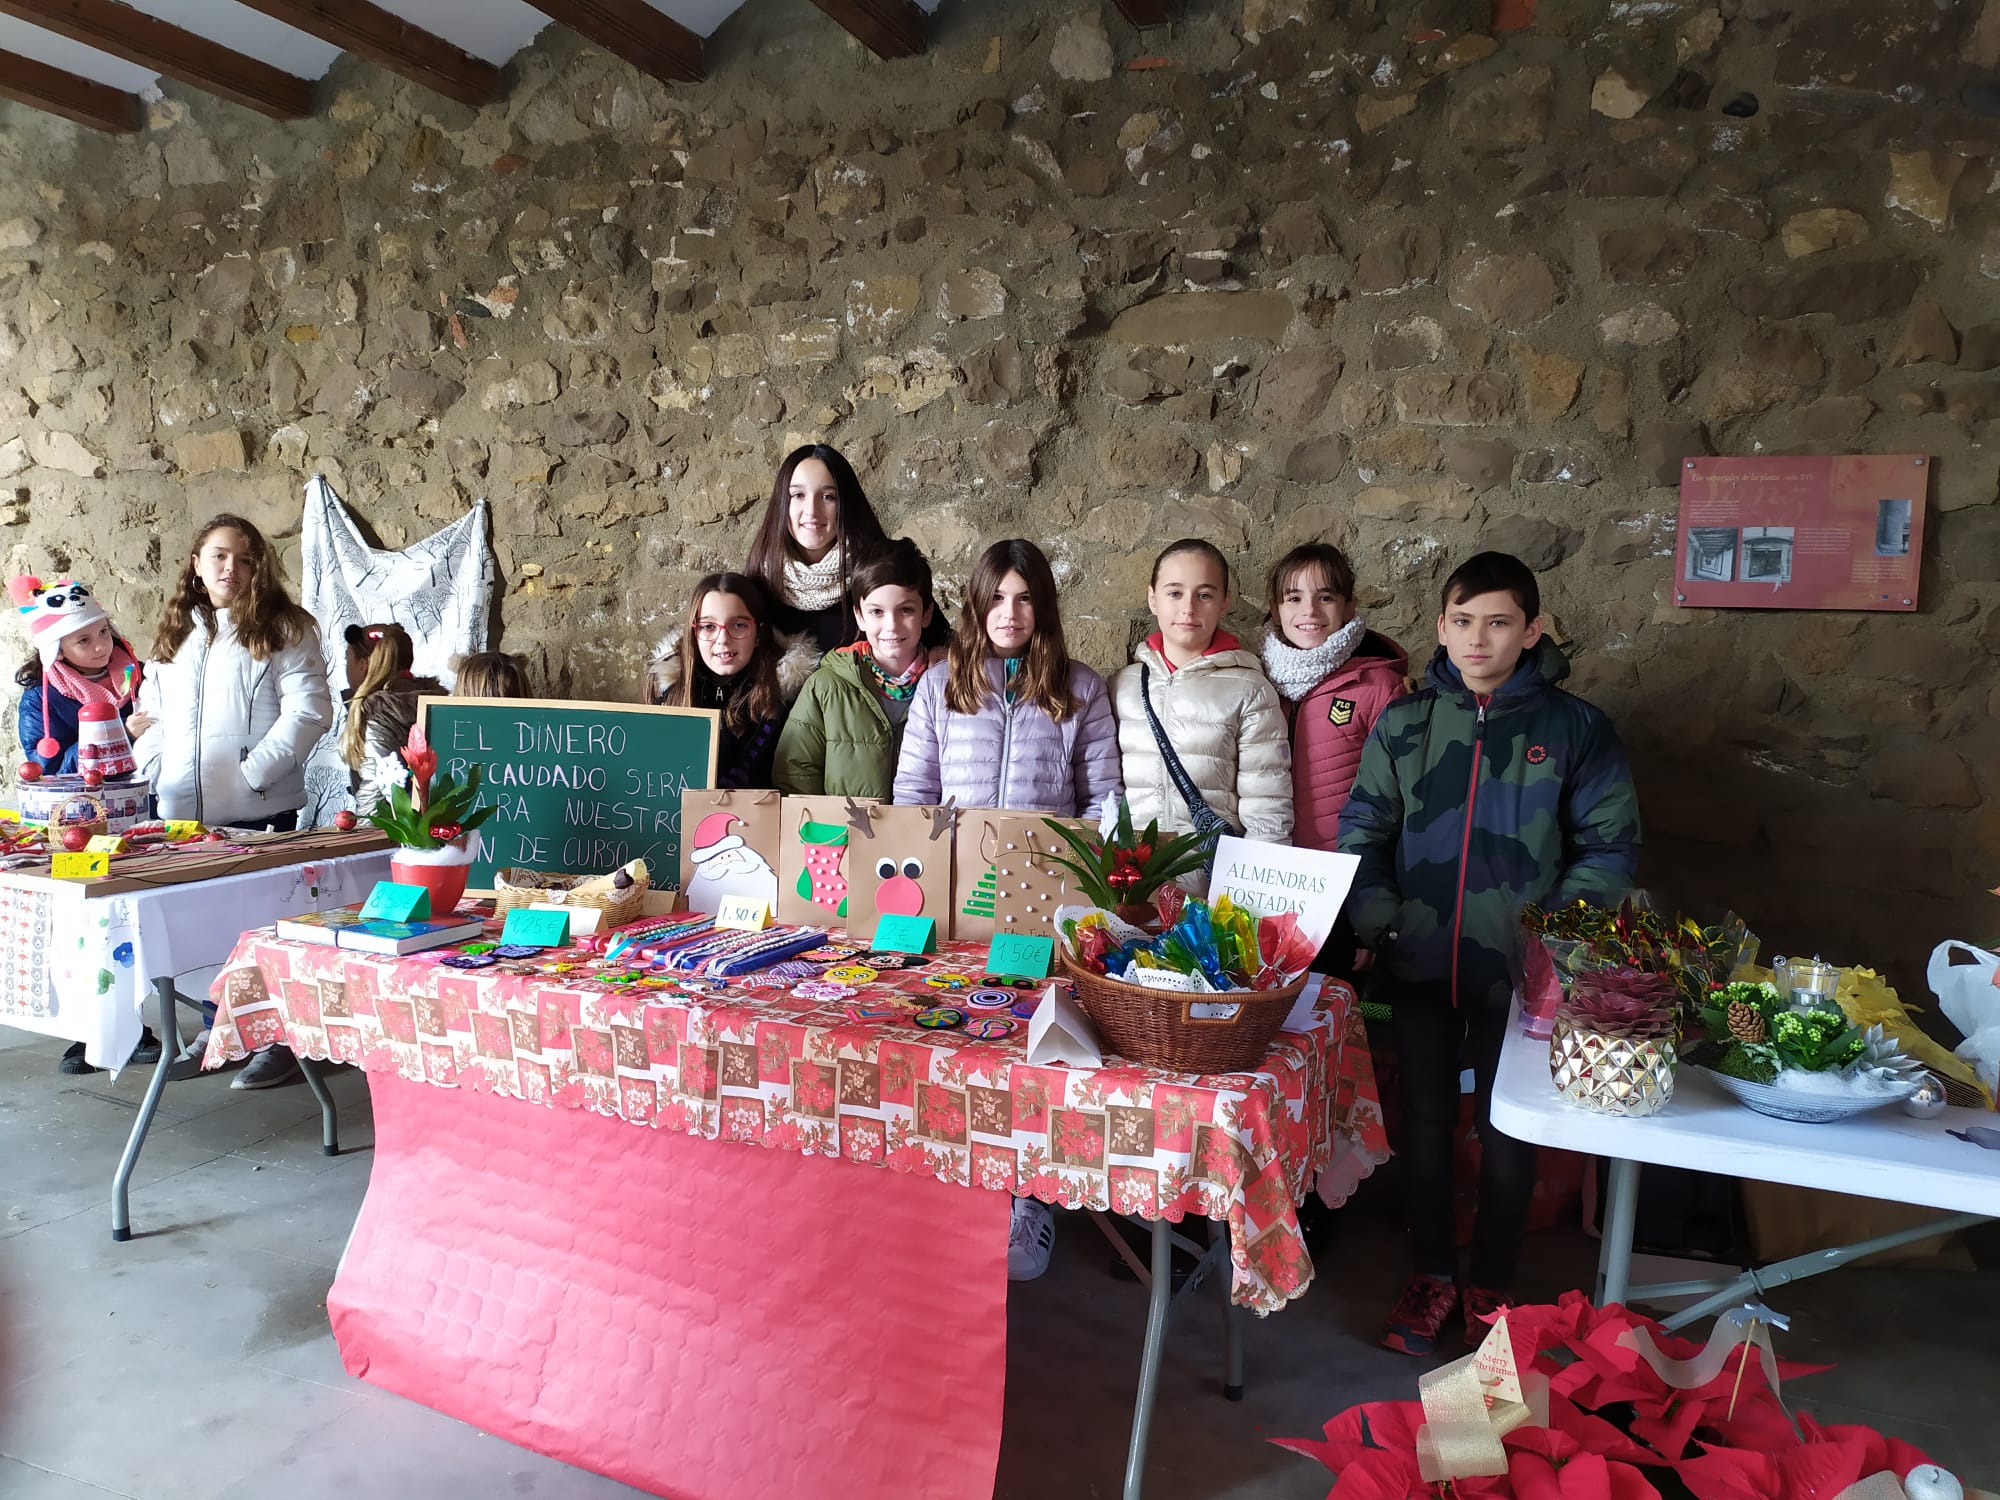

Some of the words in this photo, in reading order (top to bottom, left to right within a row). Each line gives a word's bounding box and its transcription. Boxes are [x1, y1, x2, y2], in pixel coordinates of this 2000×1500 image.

[453, 719, 493, 751] EL
[513, 721, 626, 756] DINERO
[471, 790, 531, 823] ARA
[511, 832, 551, 864] DE
[562, 836, 629, 869] CURSO
[1226, 862, 1327, 894] ALMENDRAS
[1223, 885, 1306, 917] TOSTADAS
[1482, 1353, 1508, 1367] Merry
